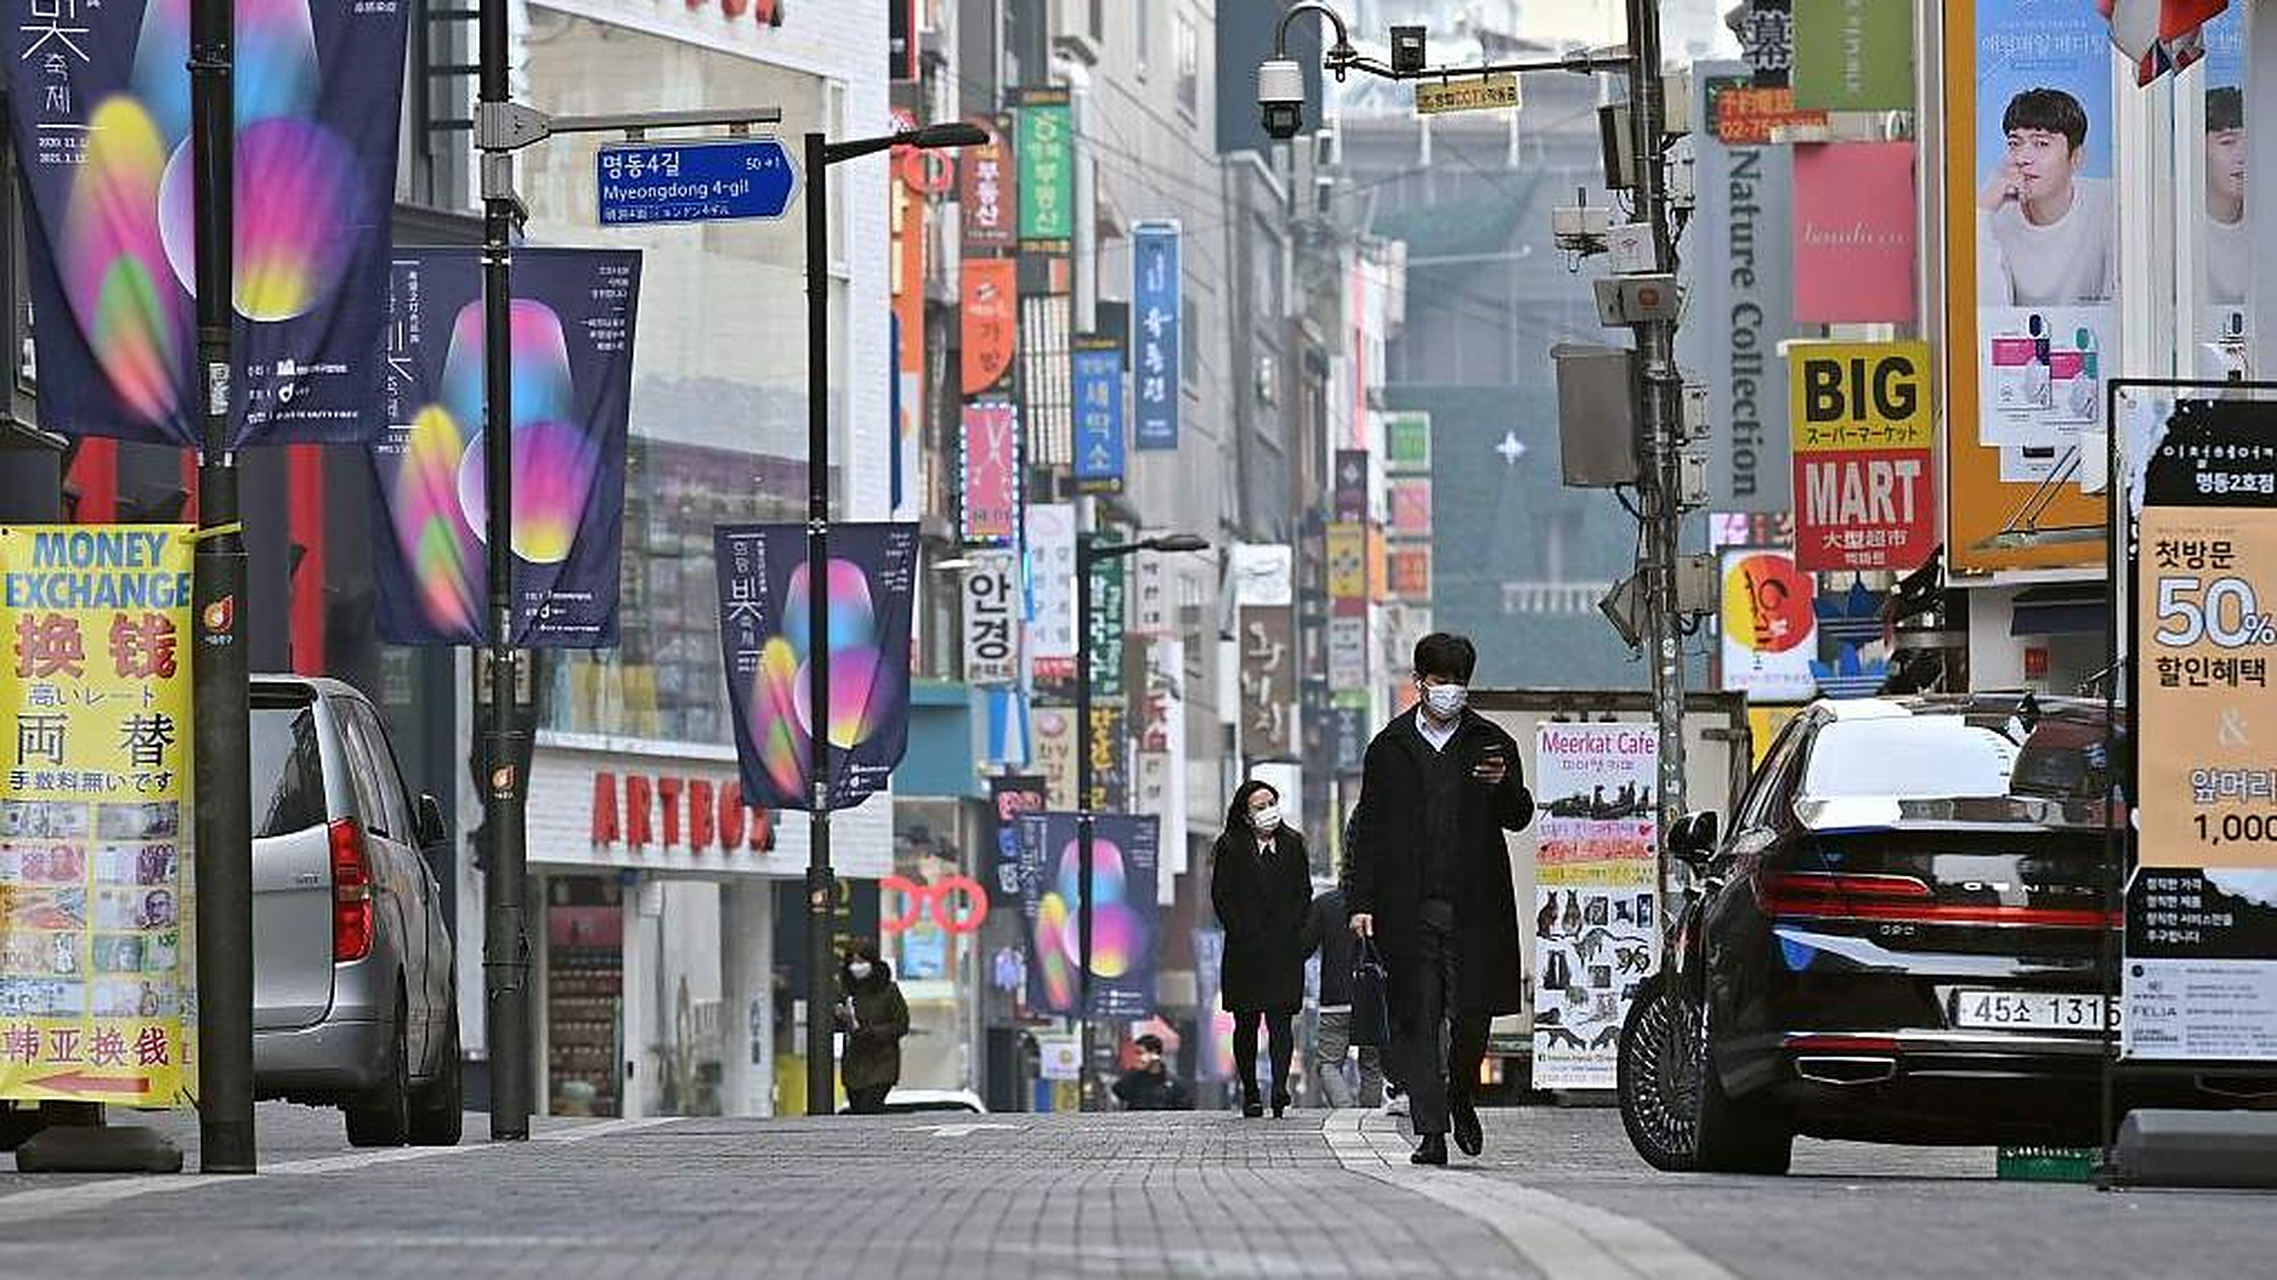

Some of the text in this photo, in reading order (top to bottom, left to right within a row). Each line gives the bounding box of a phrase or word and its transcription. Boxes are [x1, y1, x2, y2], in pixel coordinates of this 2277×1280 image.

[603, 151, 679, 180] 명동4길
[603, 179, 750, 204] Myeongdong 4-gil
[1729, 148, 1761, 288] Nature
[1731, 302, 1763, 497] Collection
[1804, 356, 1917, 421] BIG
[1807, 425, 1917, 444] スーパーマーケット
[1805, 459, 1921, 526] MART
[2196, 472, 2275, 494] 명동2호점
[34, 531, 169, 569] MONEY
[1822, 530, 1908, 550] 大型超市
[2155, 539, 2236, 569] 첫방문
[6, 572, 192, 609] EXCHANGE
[968, 572, 1012, 661] 안경
[2154, 576, 2276, 648] 50%
[2155, 656, 2266, 688] 할인혜택
[29, 684, 156, 707] 高いレート
[17, 712, 175, 767] 両替
[1542, 731, 1655, 753] Meerkat Cafe
[2191, 770, 2277, 803] 앞머리
[2194, 814, 2277, 844] 1,000
[1975, 994, 2031, 1022] 45소
[2, 1028, 169, 1066] 韩亚换钱
